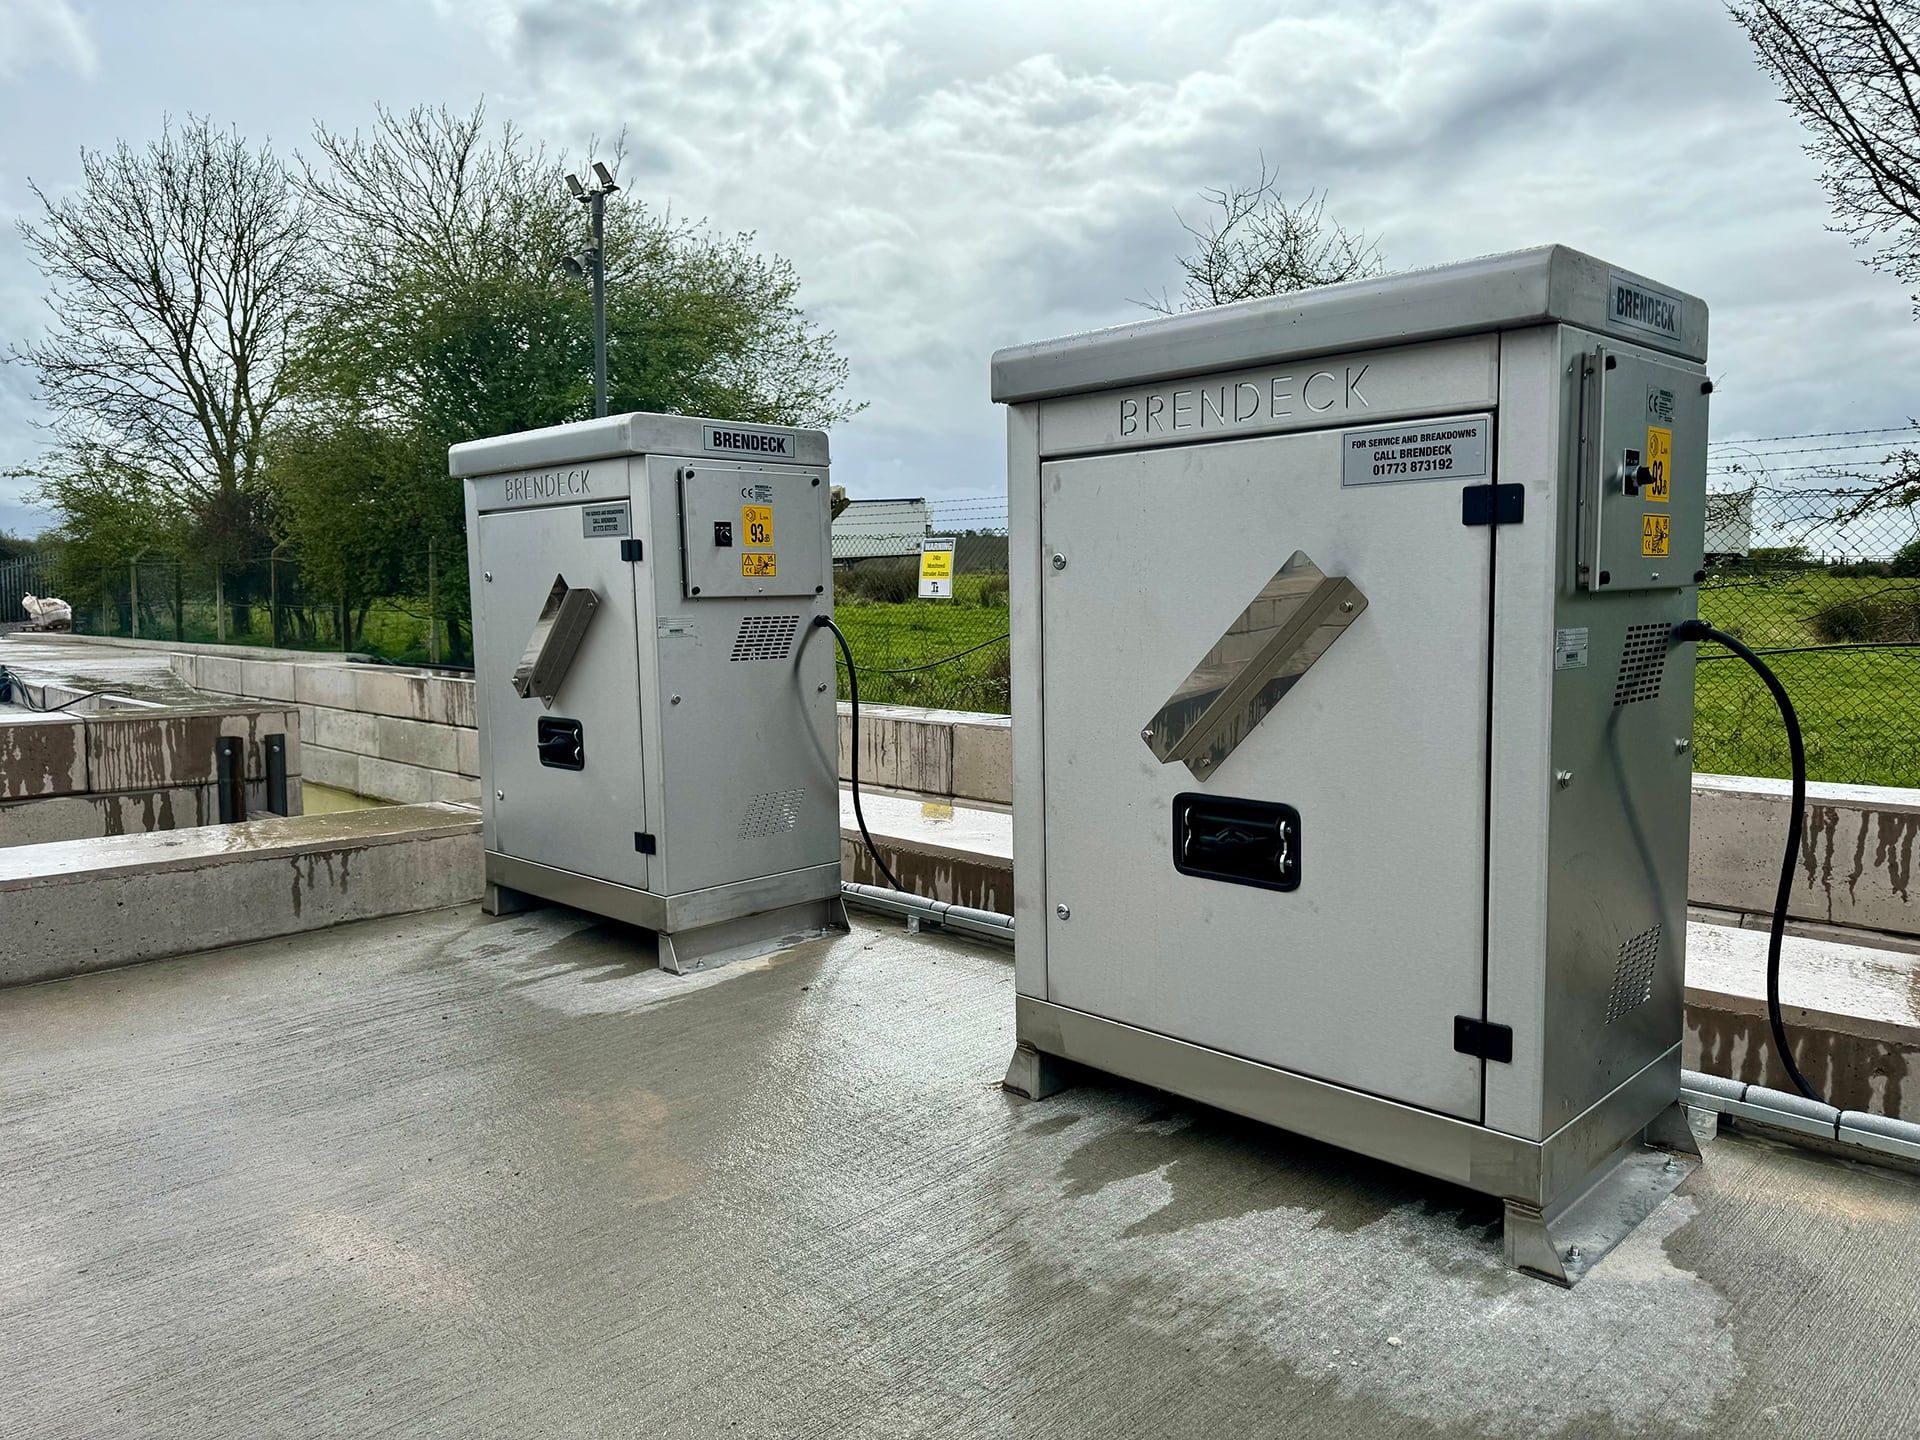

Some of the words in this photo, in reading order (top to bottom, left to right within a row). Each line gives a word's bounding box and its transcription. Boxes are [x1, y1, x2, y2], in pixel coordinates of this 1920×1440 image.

[1616, 286, 1675, 332] BRENDECK
[1120, 364, 1370, 436] BRENDECK
[713, 430, 786, 453] BRENDECK
[1351, 439, 1367, 449] FOR
[1368, 436, 1400, 447] SERVICE
[1401, 434, 1418, 444] AND
[1420, 428, 1477, 443] BREAKDOWNS
[1373, 451, 1397, 461] CALL
[1399, 444, 1452, 459] BRENDECK
[1372, 462, 1407, 476] 01773
[1410, 458, 1453, 472] 873192
[505, 469, 591, 501] BRENDECK
